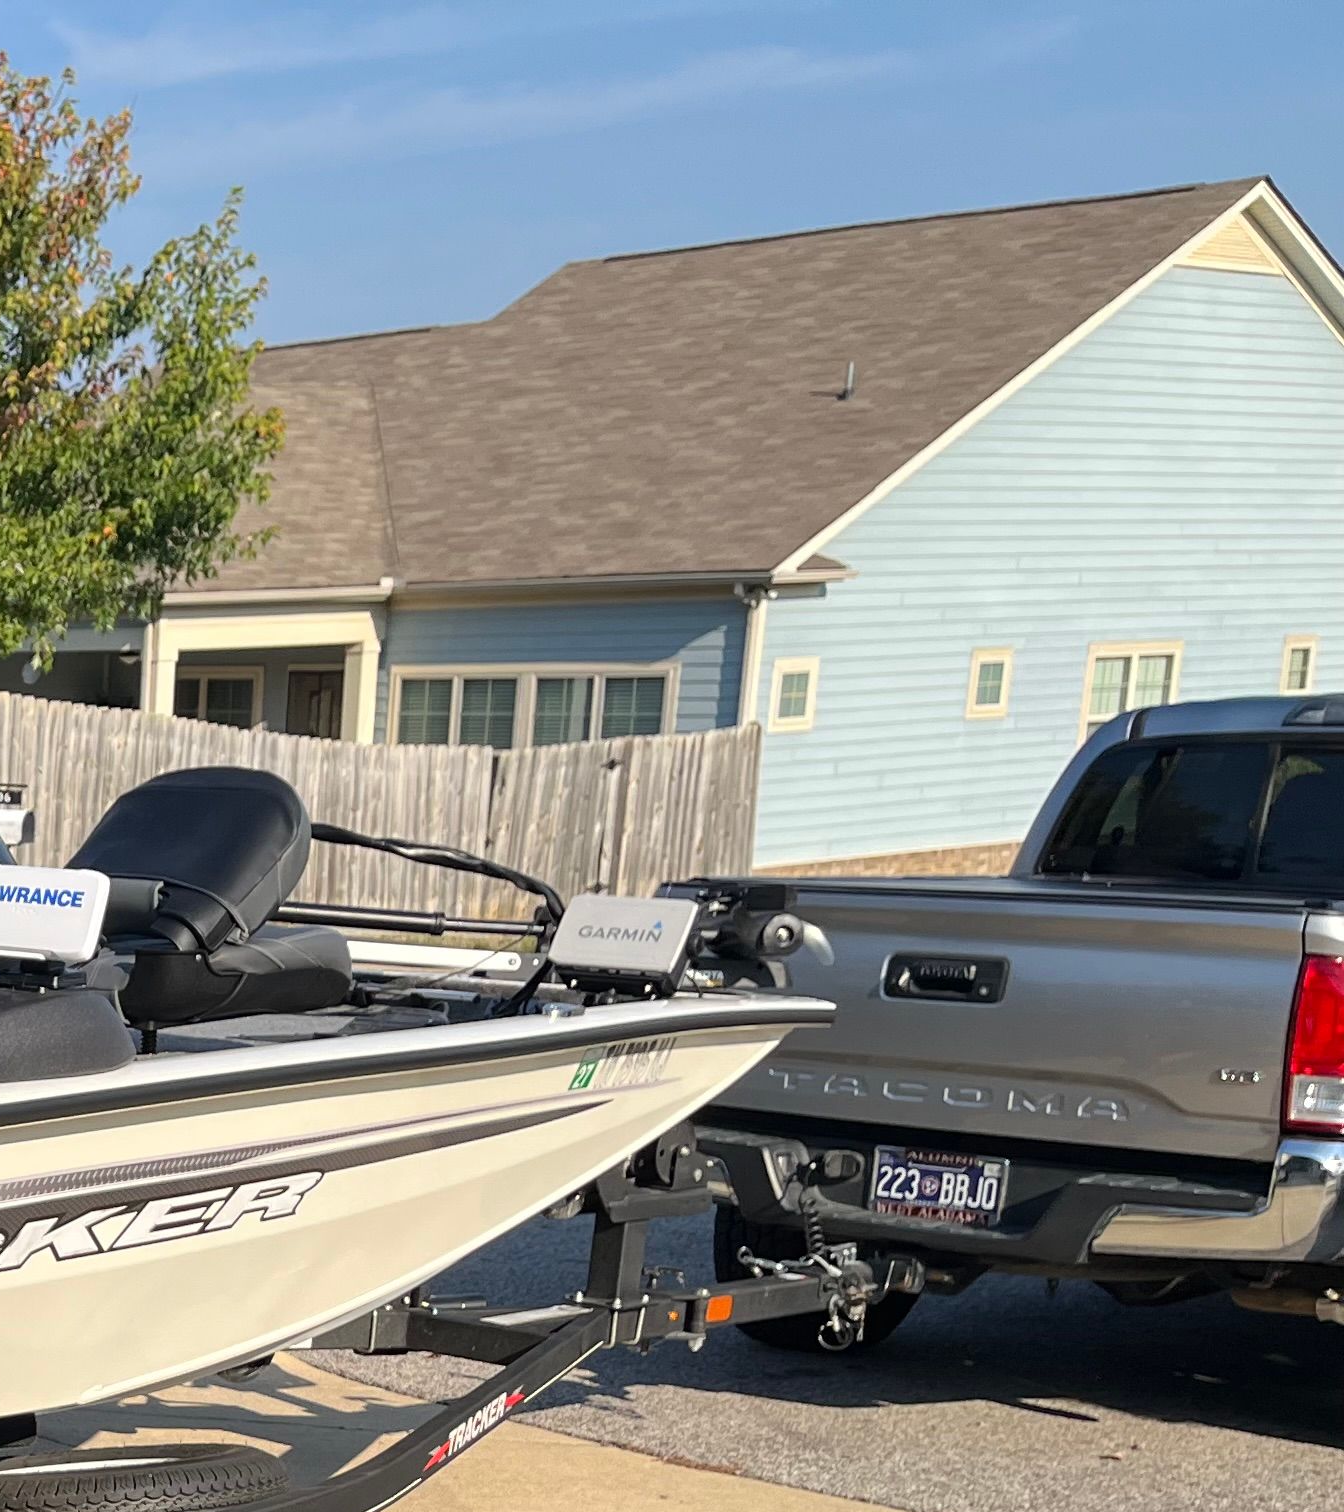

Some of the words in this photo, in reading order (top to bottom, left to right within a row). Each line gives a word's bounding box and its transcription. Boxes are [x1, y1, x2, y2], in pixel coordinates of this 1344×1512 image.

[578, 925, 663, 943] GARMIN
[768, 1068, 1130, 1122] TACOMA
[876, 1165, 921, 1201] 223
[447, 1391, 508, 1457] TRACKER
